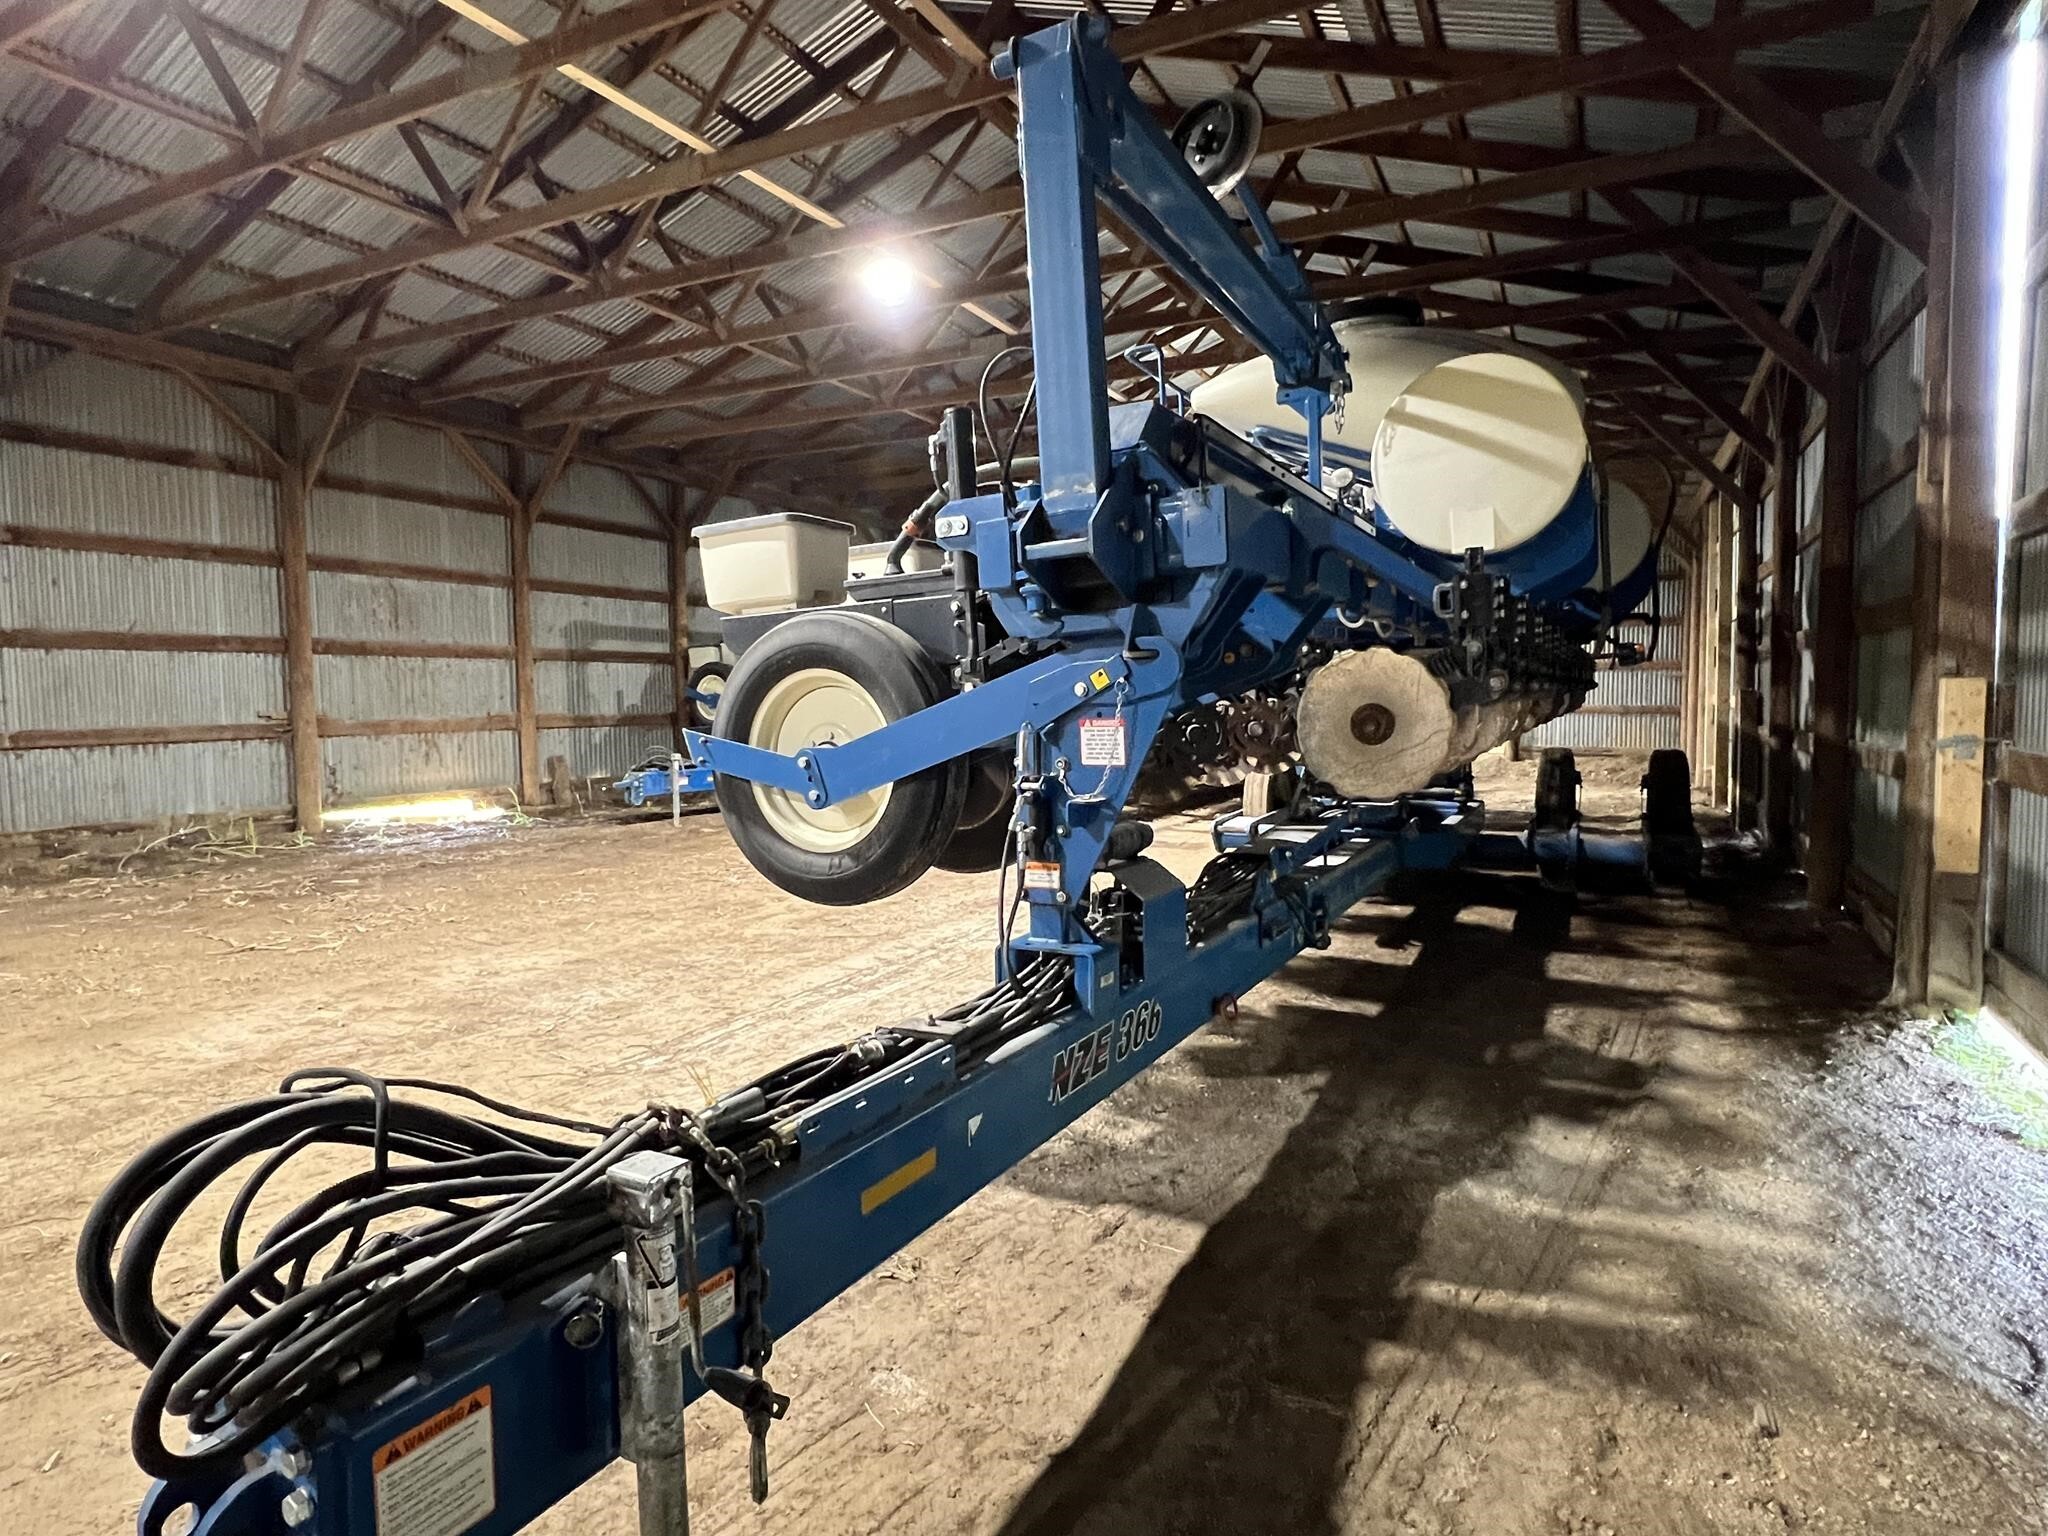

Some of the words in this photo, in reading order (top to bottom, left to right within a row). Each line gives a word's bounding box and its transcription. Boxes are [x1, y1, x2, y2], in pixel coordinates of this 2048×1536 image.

[1047, 1019, 1115, 1106] NZE
[1116, 997, 1162, 1062] 366
[403, 1406, 466, 1452] WARNING
